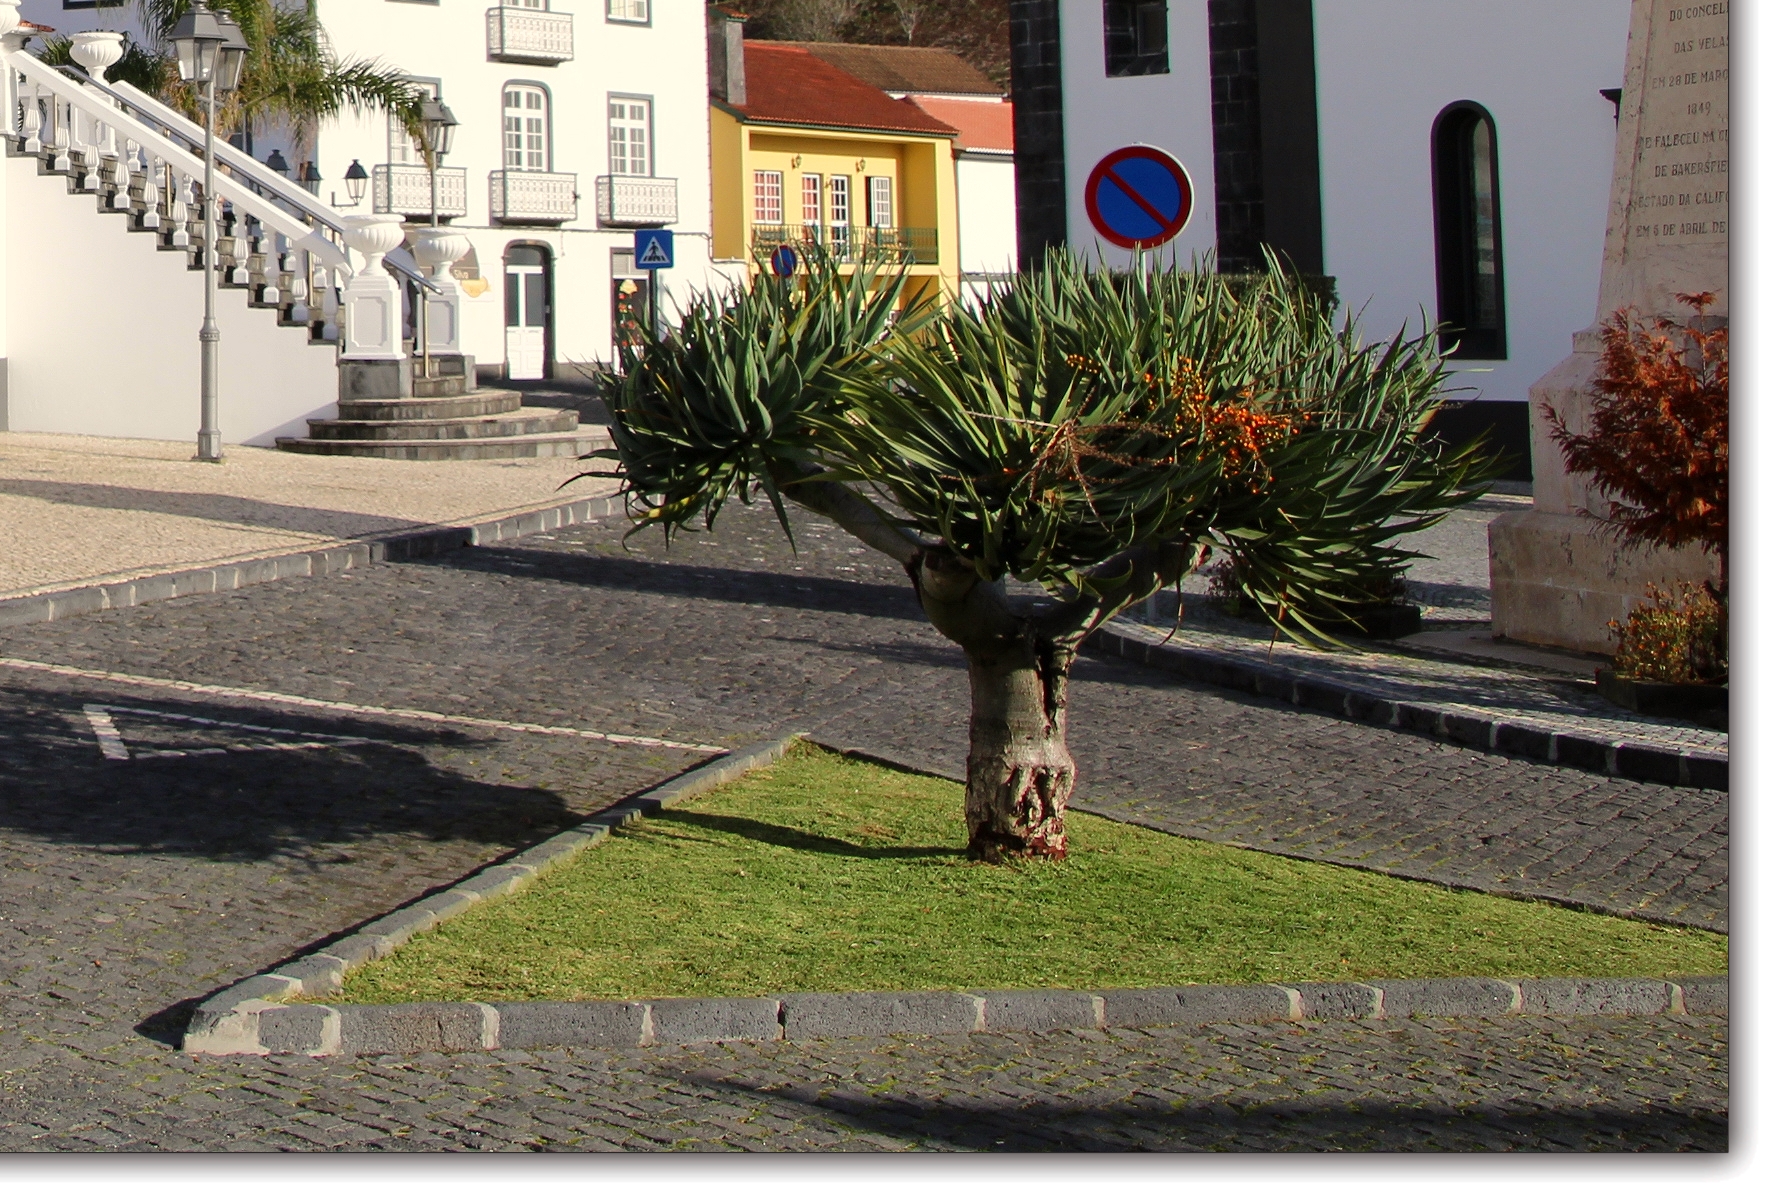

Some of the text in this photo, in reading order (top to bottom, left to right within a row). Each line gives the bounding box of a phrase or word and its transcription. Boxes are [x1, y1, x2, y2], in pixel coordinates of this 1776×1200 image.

[1669, 2, 1728, 21] DO CONCEL
[1674, 41, 1693, 53] DAS
[1652, 77, 1665, 89] EM
[1669, 75, 1681, 87] 28
[1685, 72, 1697, 85] DE
[1688, 102, 1711, 115] 1849
[1655, 160, 1728, 177] DE BAKERSFIE
[1679, 194, 1690, 205] DA
[1663, 224, 1675, 235] DE
[1679, 221, 1707, 235] ABRIL
[1712, 221, 1726, 233] DE
